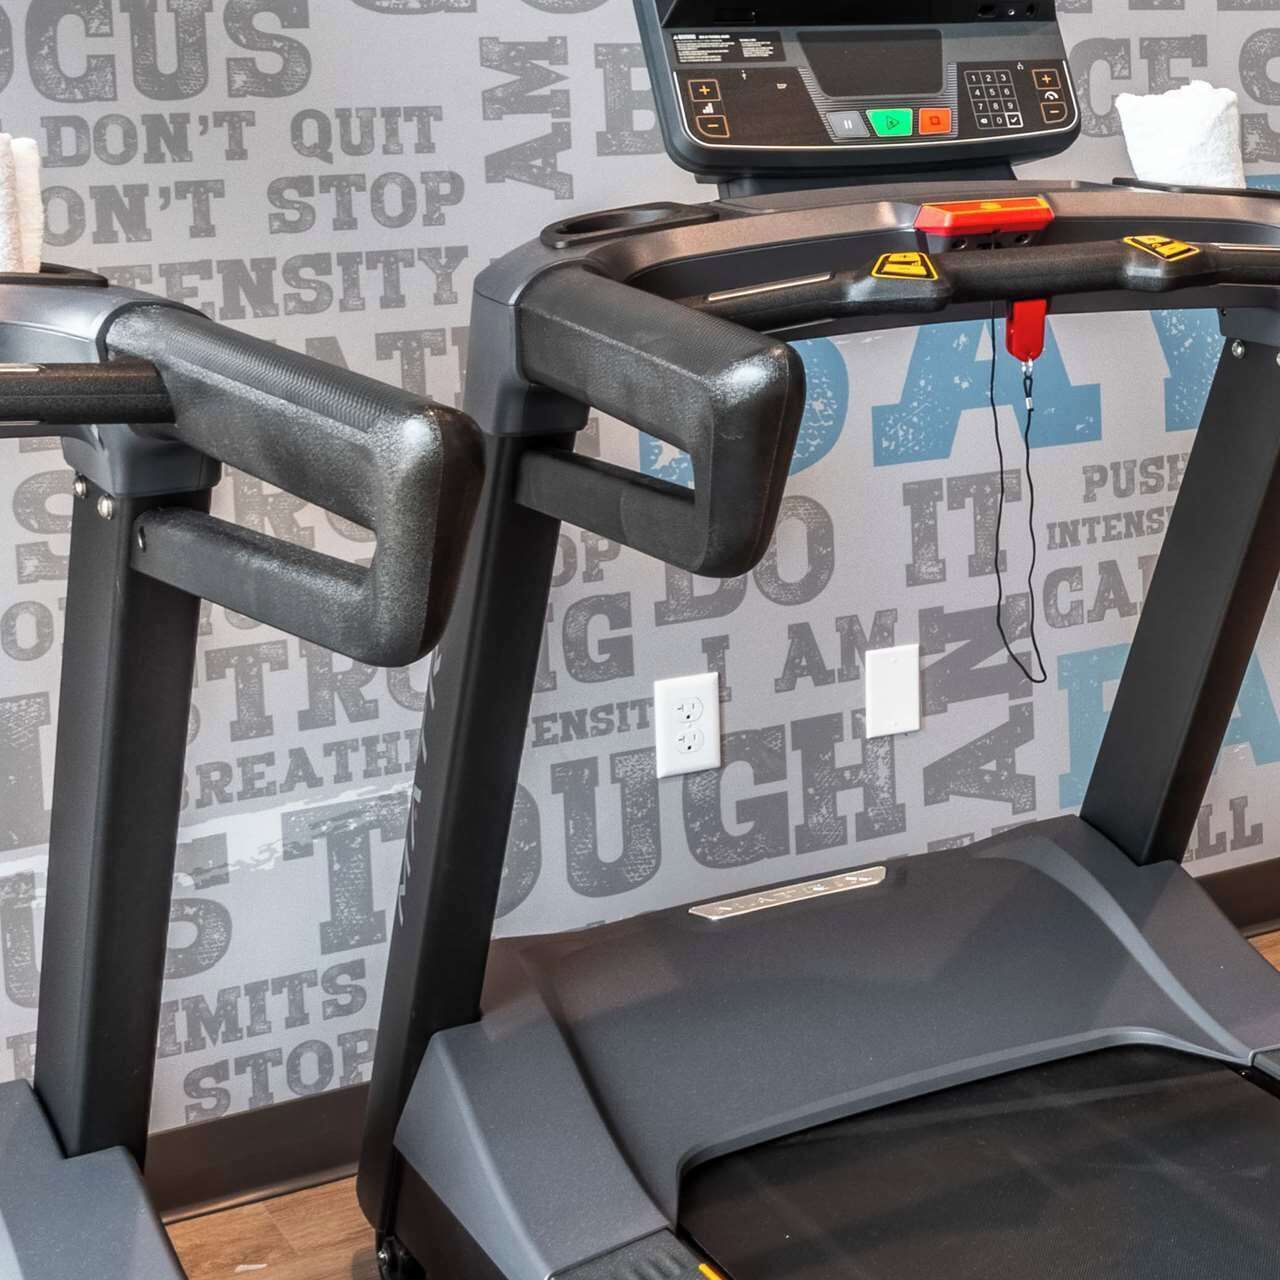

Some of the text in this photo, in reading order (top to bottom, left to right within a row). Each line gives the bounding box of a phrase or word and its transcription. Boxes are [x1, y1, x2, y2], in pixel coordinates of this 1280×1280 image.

[41, 106, 443, 169] DON'T QUIT
[479, 36, 573, 200] AM
[266, 171, 465, 234] STOP
[902, 469, 1022, 588] IT
[1046, 506, 1174, 550] INTENS
